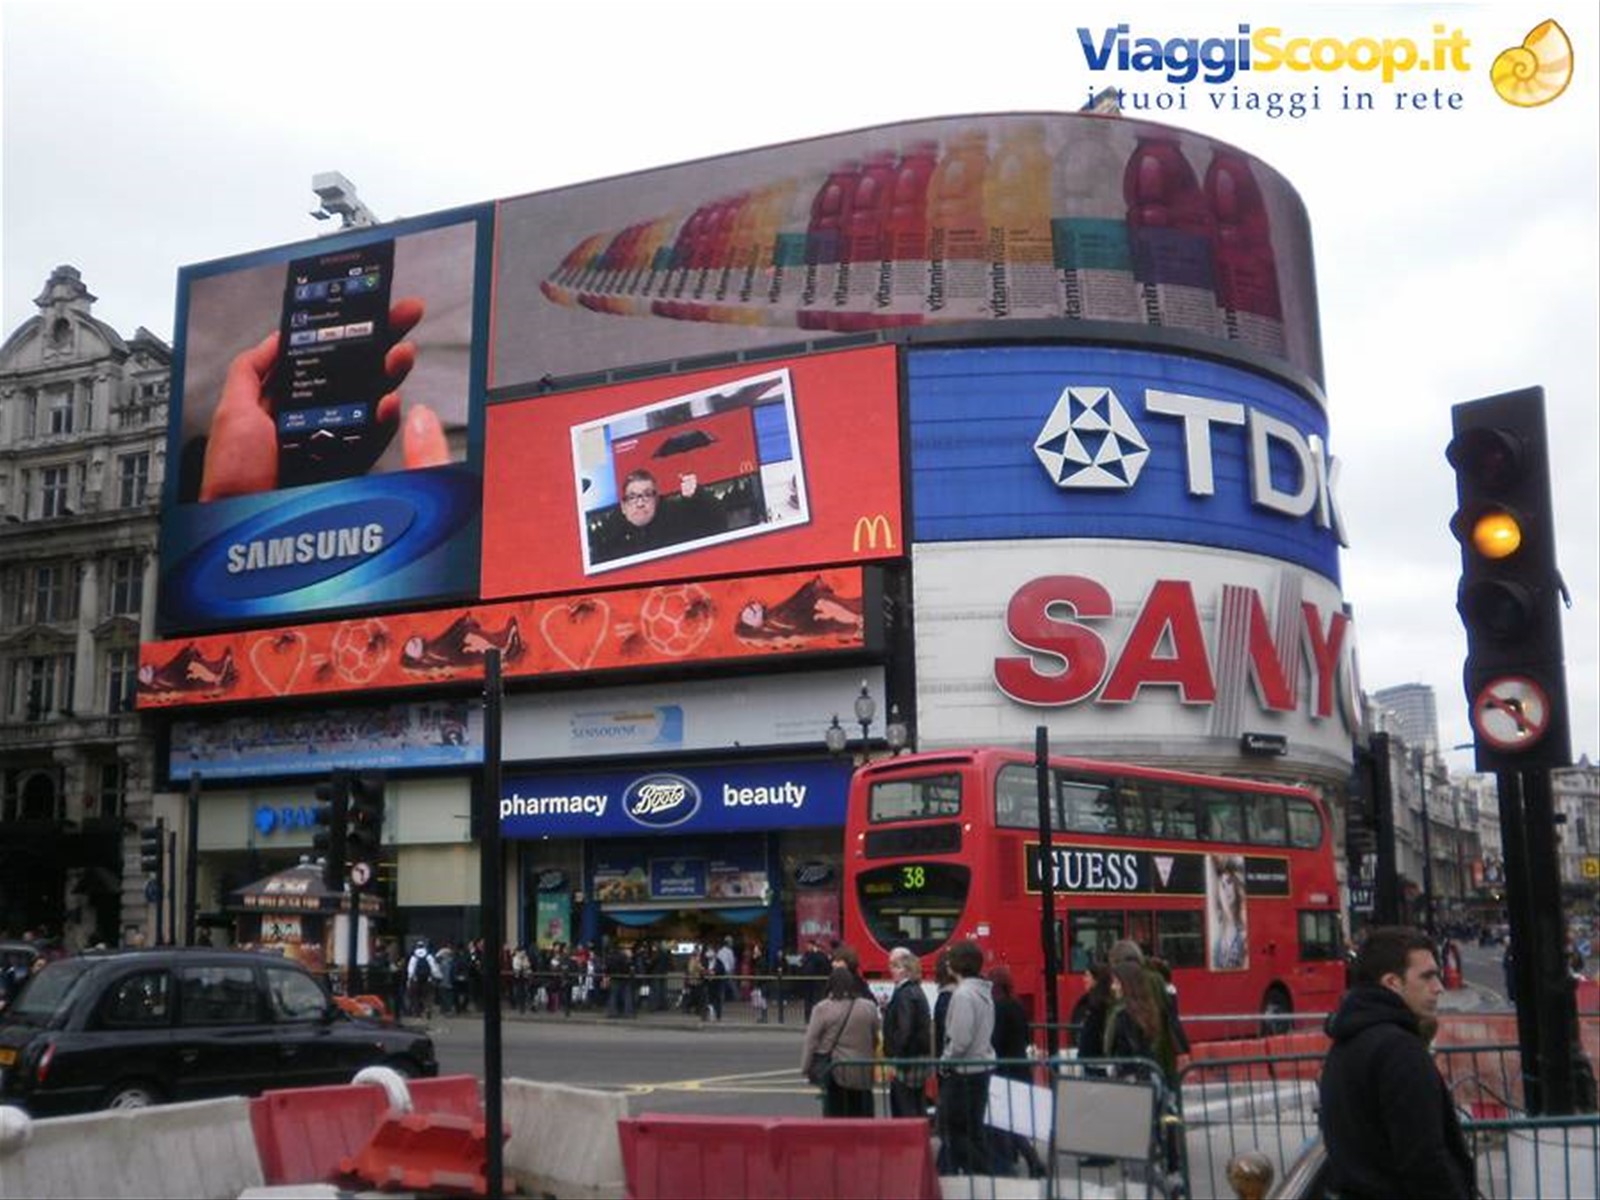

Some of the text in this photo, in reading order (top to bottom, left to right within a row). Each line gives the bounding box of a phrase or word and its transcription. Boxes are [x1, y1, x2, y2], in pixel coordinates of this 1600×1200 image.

[1145, 388, 1350, 549] TDK
[227, 523, 384, 573] SAMSUNG
[500, 781, 807, 819] pharmacy Boots beauty
[902, 866, 926, 889] 38
